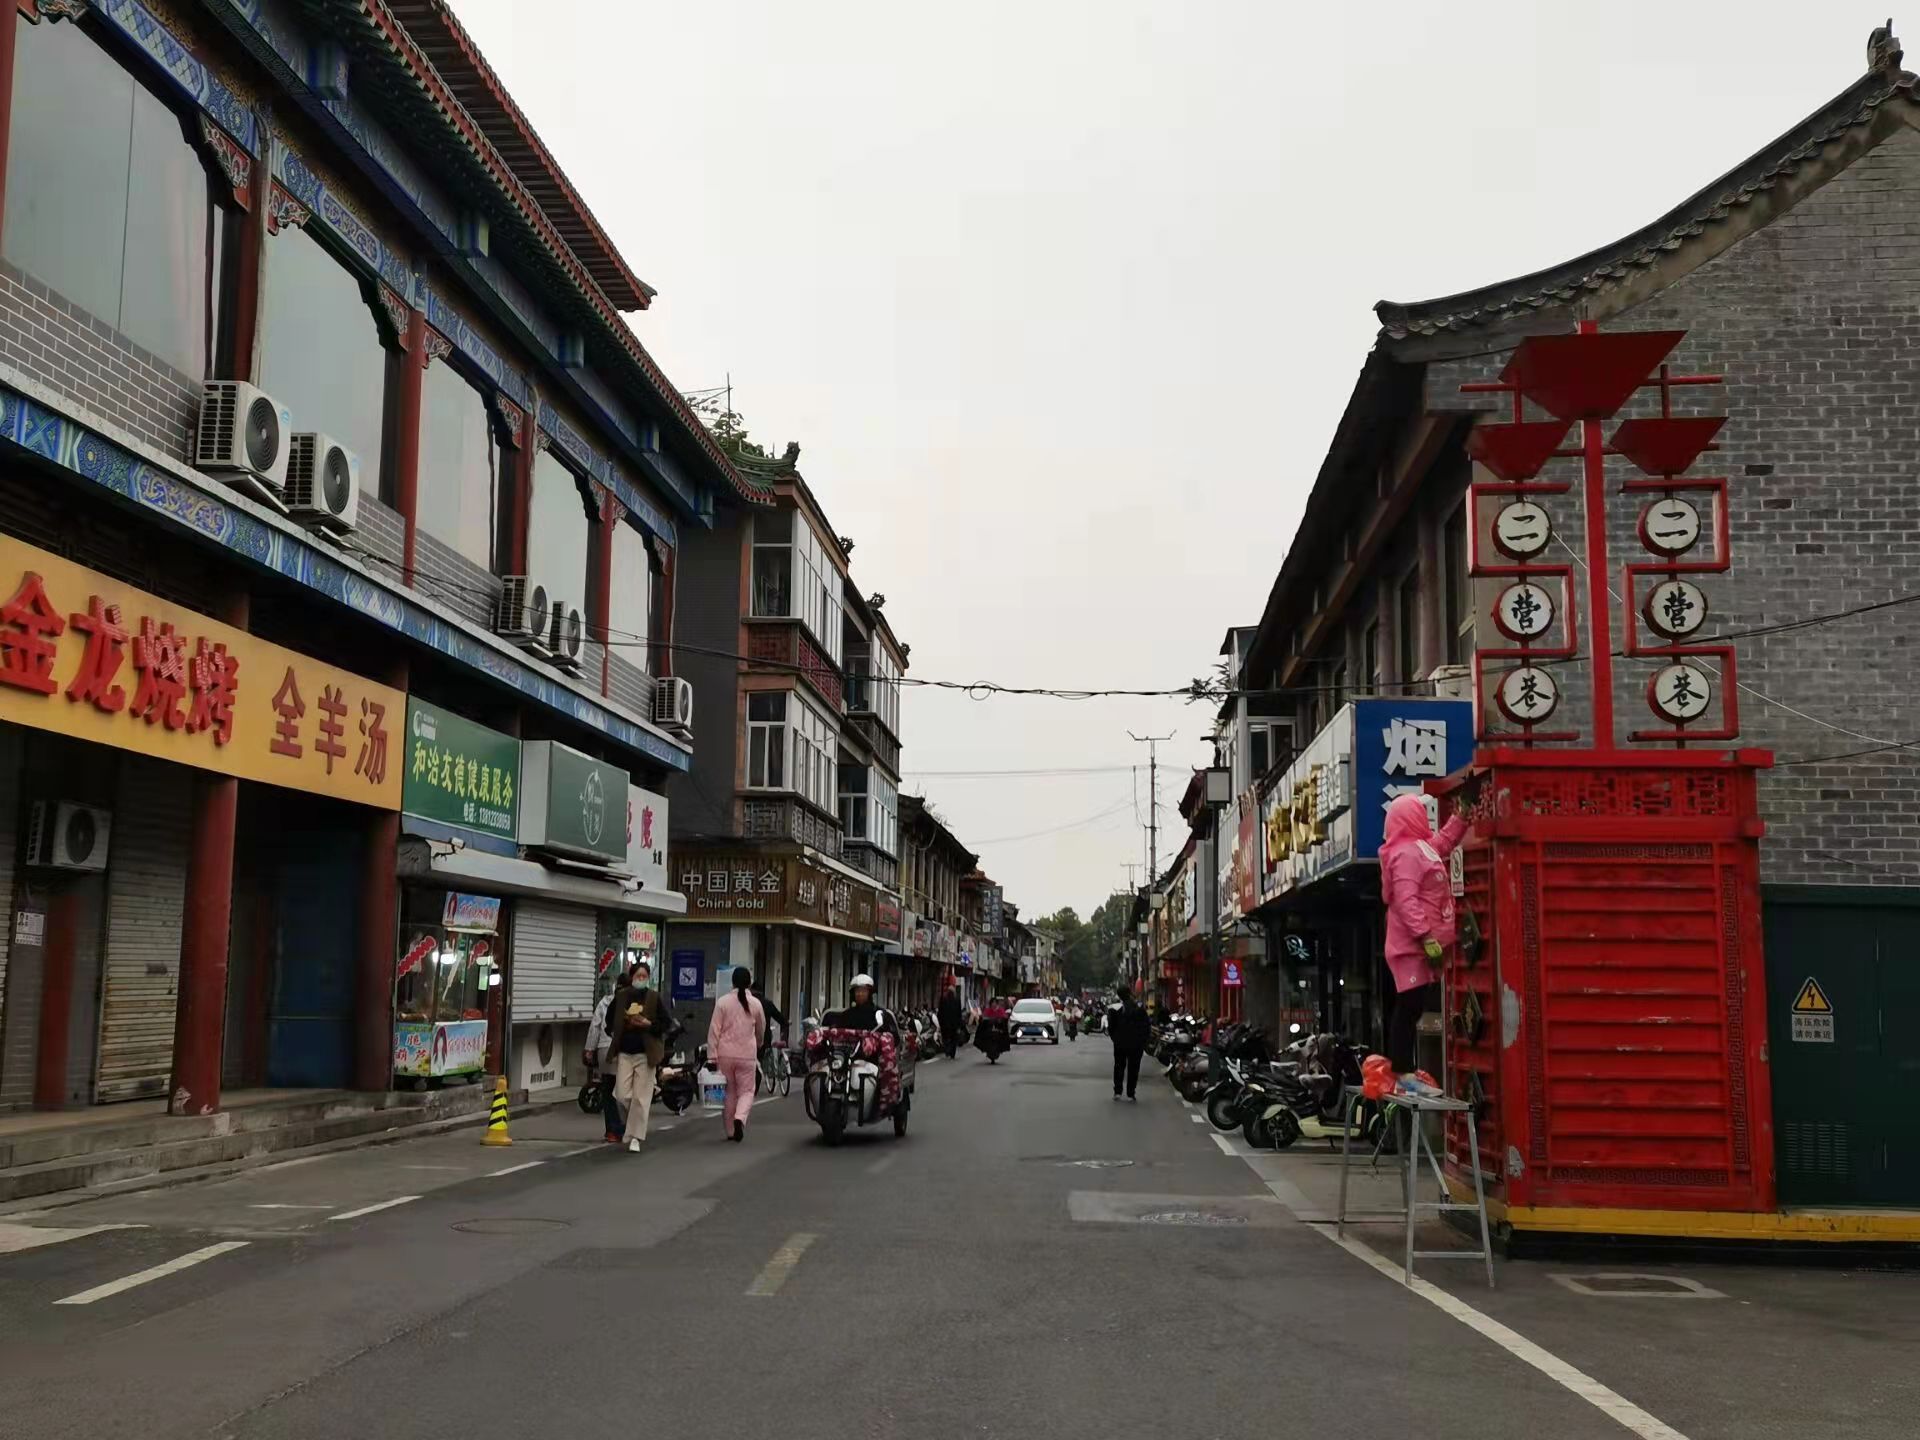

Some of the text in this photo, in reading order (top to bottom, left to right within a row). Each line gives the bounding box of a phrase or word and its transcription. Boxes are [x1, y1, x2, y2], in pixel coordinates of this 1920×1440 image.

[1505, 514, 1553, 712] 二营巷
[1655, 511, 1705, 712] 二营巷
[0, 571, 389, 785] 金龙烧烤 全羊汤
[412, 740, 514, 809] 和治友德健康服务
[682, 870, 781, 894] 中国黄金
[696, 897, 765, 909] China Gold
[1795, 1018, 1830, 1027] 高压危险
[1796, 1030, 1832, 1040] 请勿靠近
